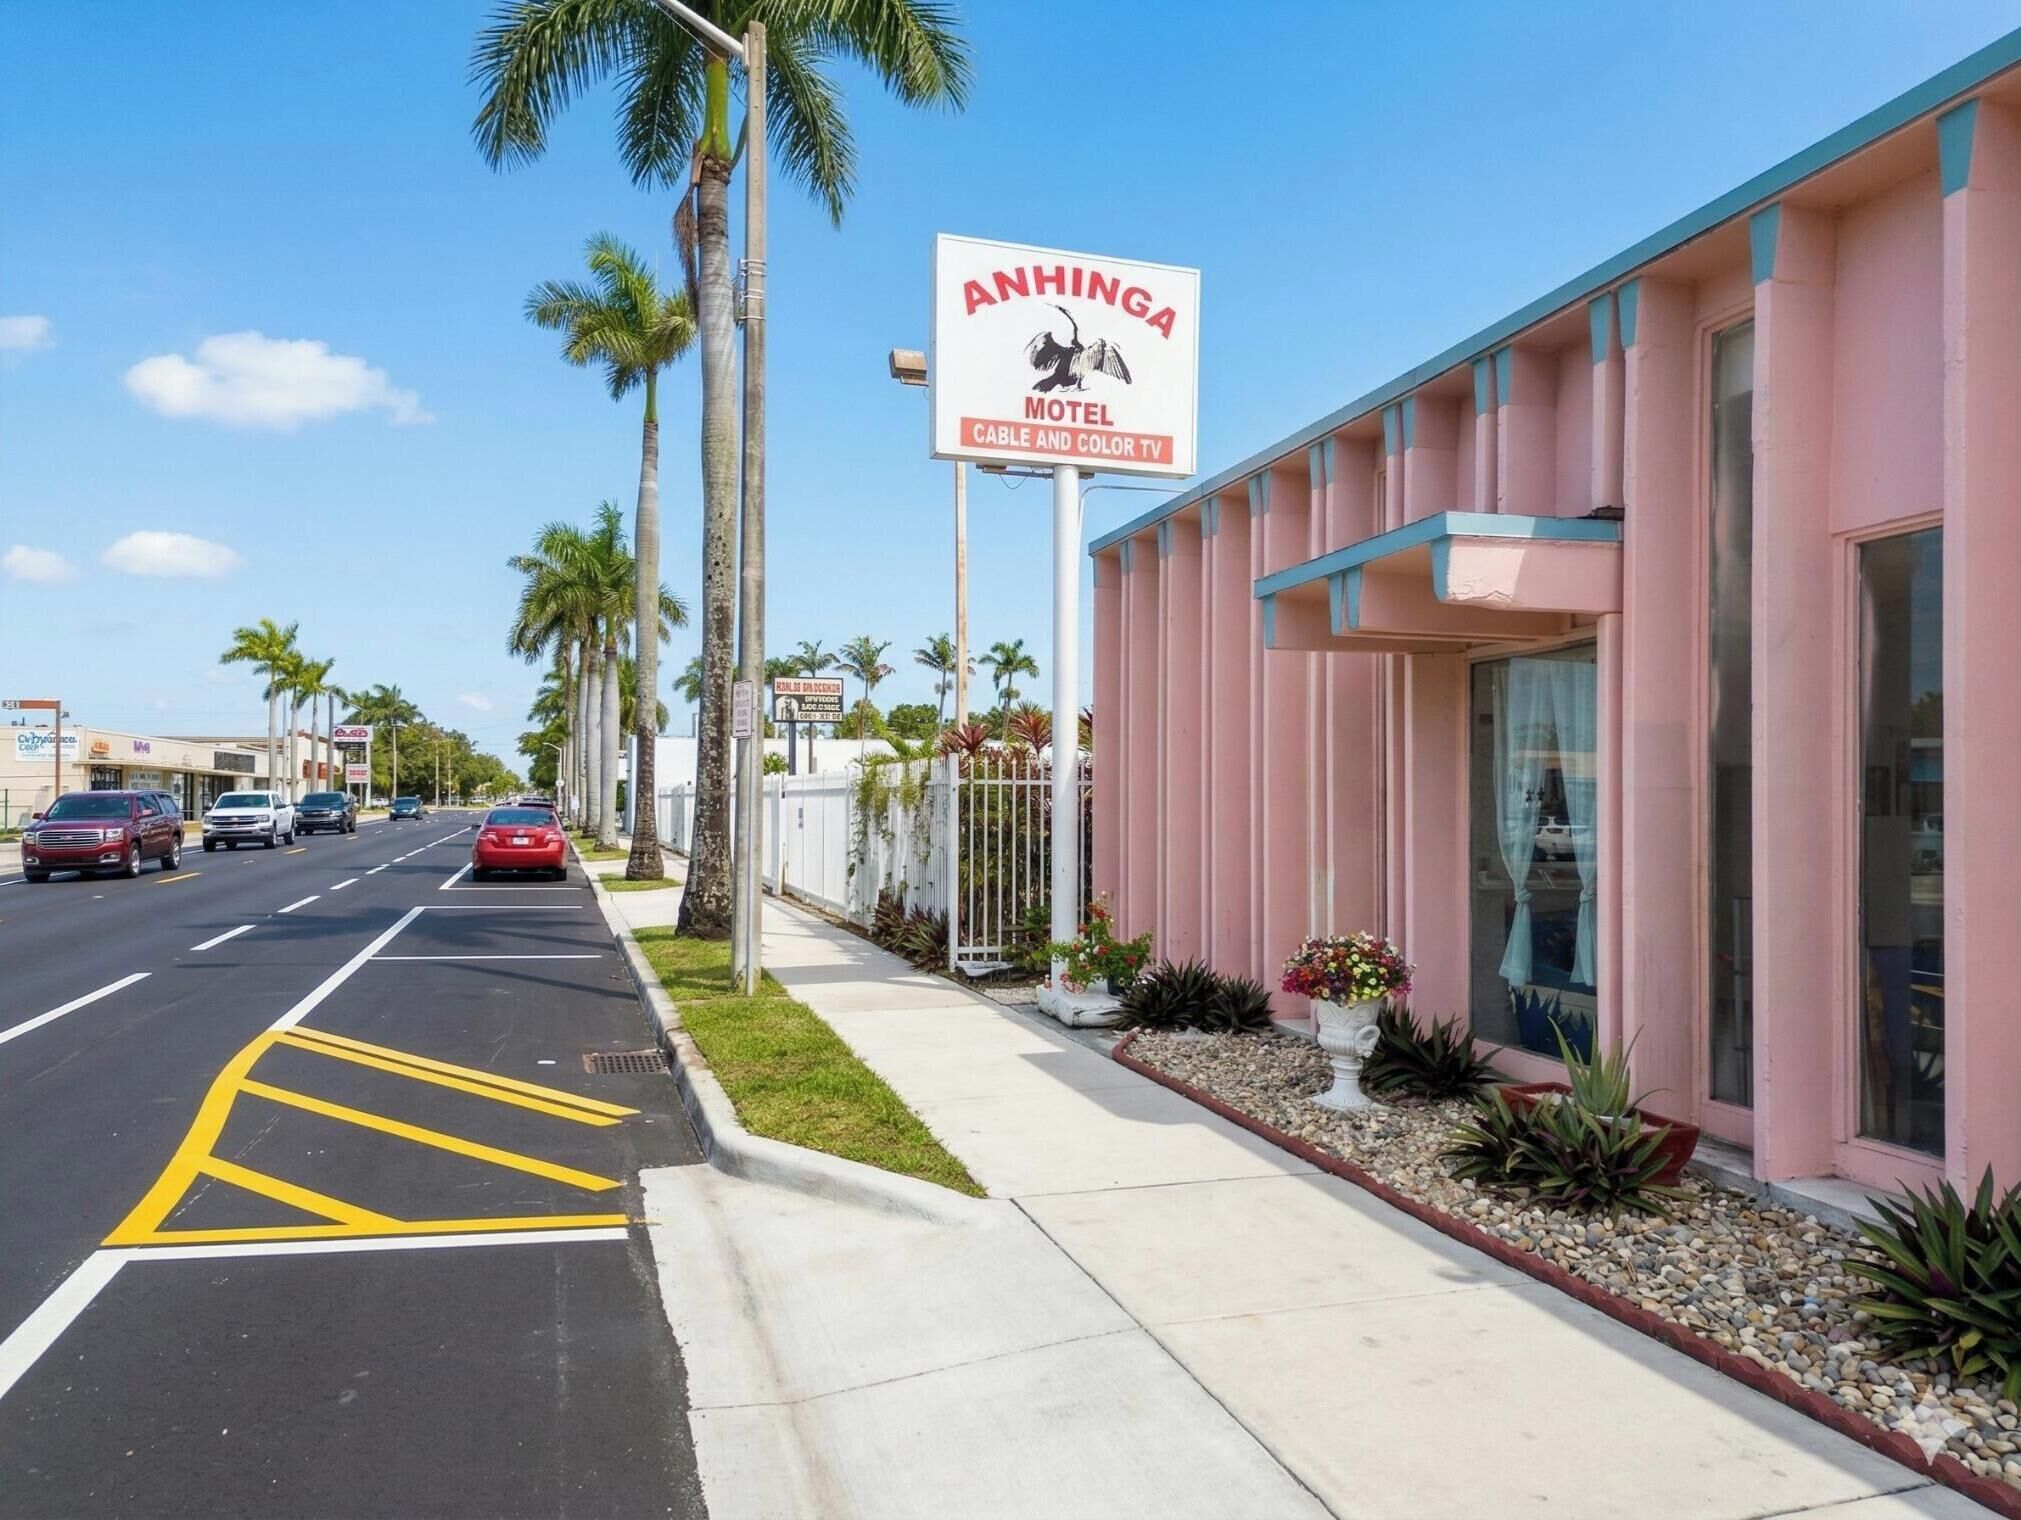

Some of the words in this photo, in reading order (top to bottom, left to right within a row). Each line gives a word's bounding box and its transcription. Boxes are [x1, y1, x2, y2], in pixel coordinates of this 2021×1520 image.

[963, 265, 1176, 340] ANHINGA
[1024, 396, 1114, 427] MOTEL
[973, 422, 1031, 447] CABLE
[1036, 429, 1071, 451] AND
[1077, 433, 1135, 457] COLOR
[1140, 438, 1162, 459] TV
